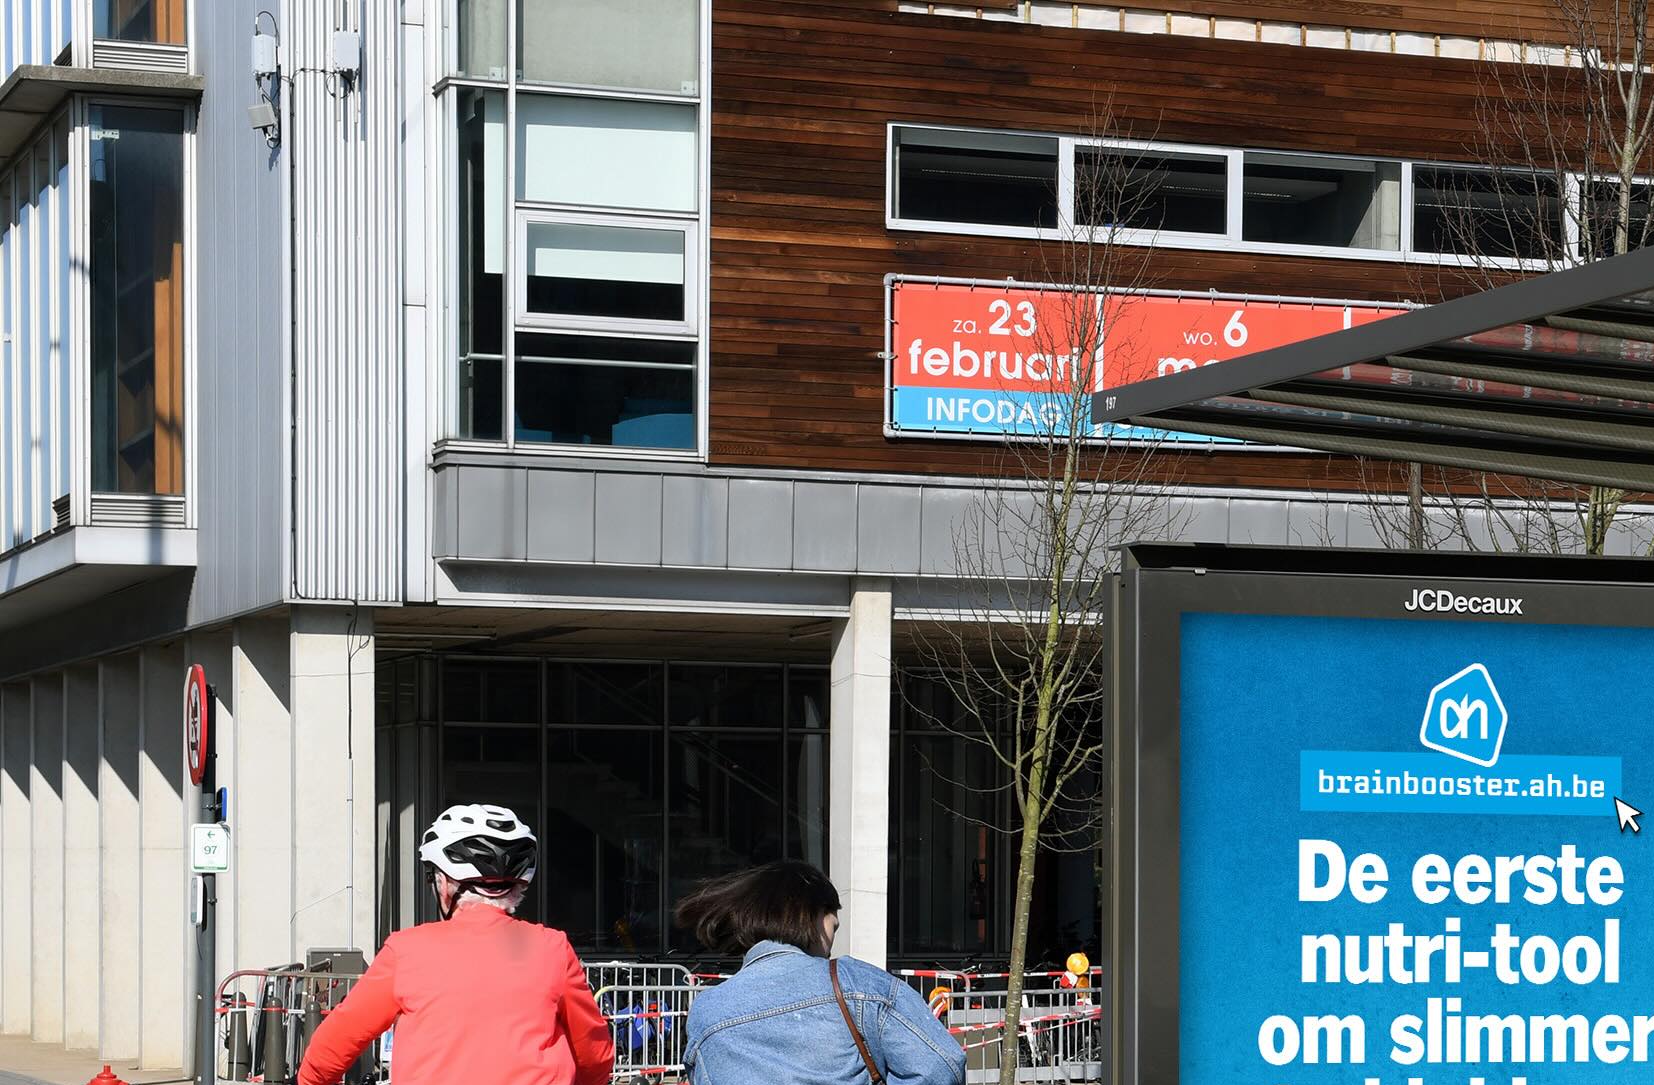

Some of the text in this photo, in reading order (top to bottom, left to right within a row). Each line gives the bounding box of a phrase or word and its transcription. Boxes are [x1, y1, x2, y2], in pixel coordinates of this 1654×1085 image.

[953, 298, 1037, 337] za. 23
[1183, 310, 1248, 347] wo. 6
[908, 338, 1079, 382] februari
[927, 397, 1062, 425] INFODAG
[1104, 396, 1117, 411] 197
[1405, 589, 1523, 614] JCDecaux
[1318, 768, 1606, 799] brainbooster.ah.be
[203, 845, 217, 855] 97
[1297, 839, 1625, 906] De eerste
[1300, 917, 1621, 985] nutri-tool
[1257, 1014, 1367, 1066] om
